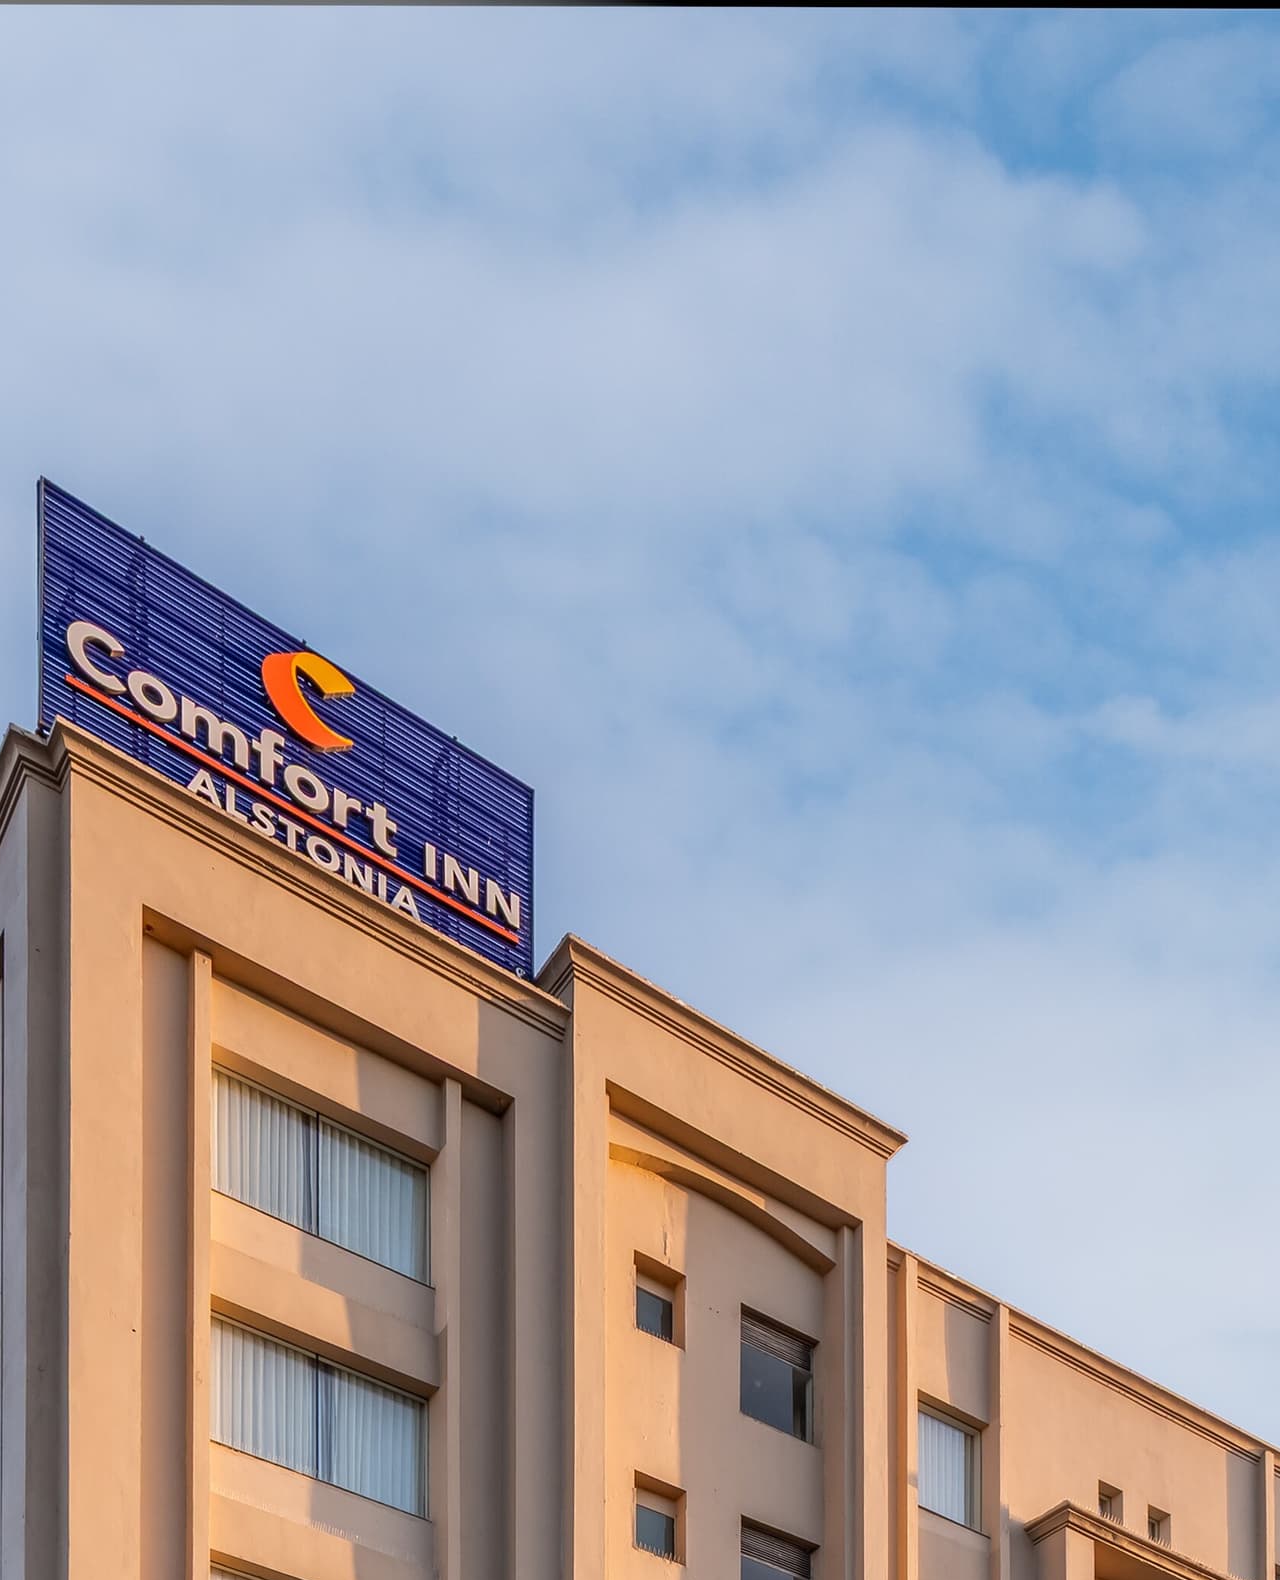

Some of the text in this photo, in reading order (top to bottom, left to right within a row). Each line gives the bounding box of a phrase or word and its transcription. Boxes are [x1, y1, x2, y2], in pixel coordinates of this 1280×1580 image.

[66, 621, 521, 929] Comfort INN
[187, 768, 421, 919] ALSTONIA
